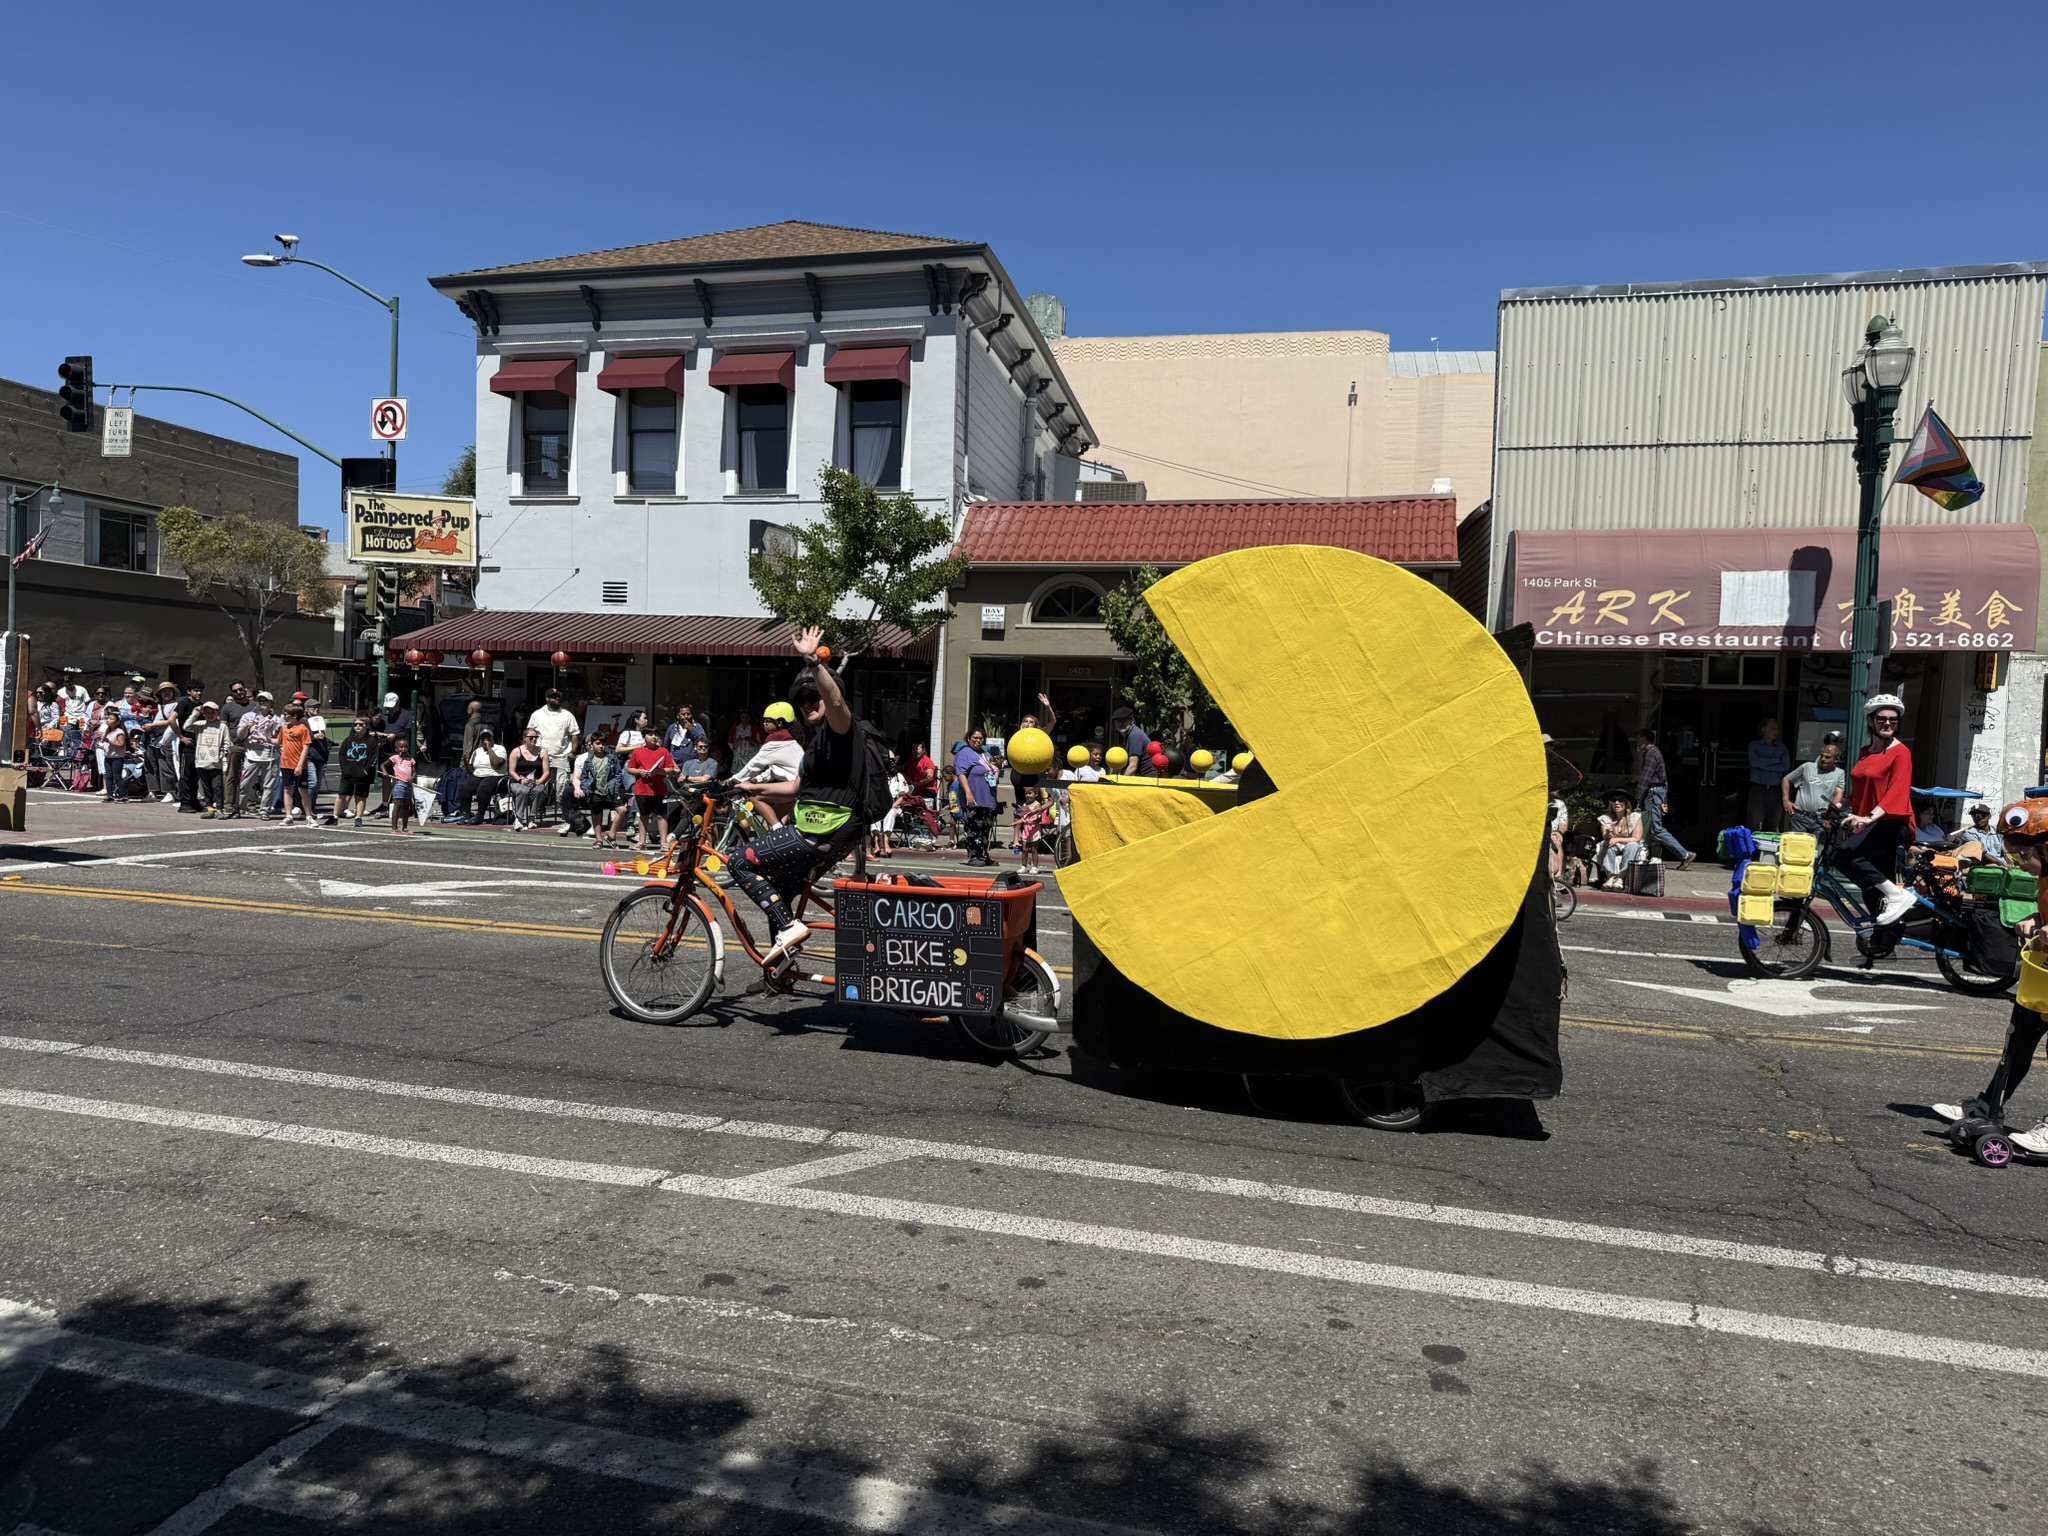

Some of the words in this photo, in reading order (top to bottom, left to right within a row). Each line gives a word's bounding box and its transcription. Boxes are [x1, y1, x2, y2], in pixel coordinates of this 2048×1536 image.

[355, 503, 433, 527] Pampered
[441, 509, 470, 531] Pup
[368, 498, 386, 511] The
[365, 534, 386, 549] HOT
[386, 535, 412, 550] DOGS
[373, 528, 407, 539] Deluxe
[1522, 577, 1551, 588] 1405
[1553, 577, 1581, 588] Park
[1584, 577, 1598, 588] St
[1545, 589, 1692, 627] ARK
[1535, 630, 1650, 647] Chinese
[1658, 632, 1820, 648] Restaurant
[1905, 631, 2014, 648] 521-6862
[2, 664, 13, 723] RADAR
[874, 898, 955, 930] CARGO
[886, 938, 946, 966] BIKE
[870, 975, 963, 1007] BRIGADE
